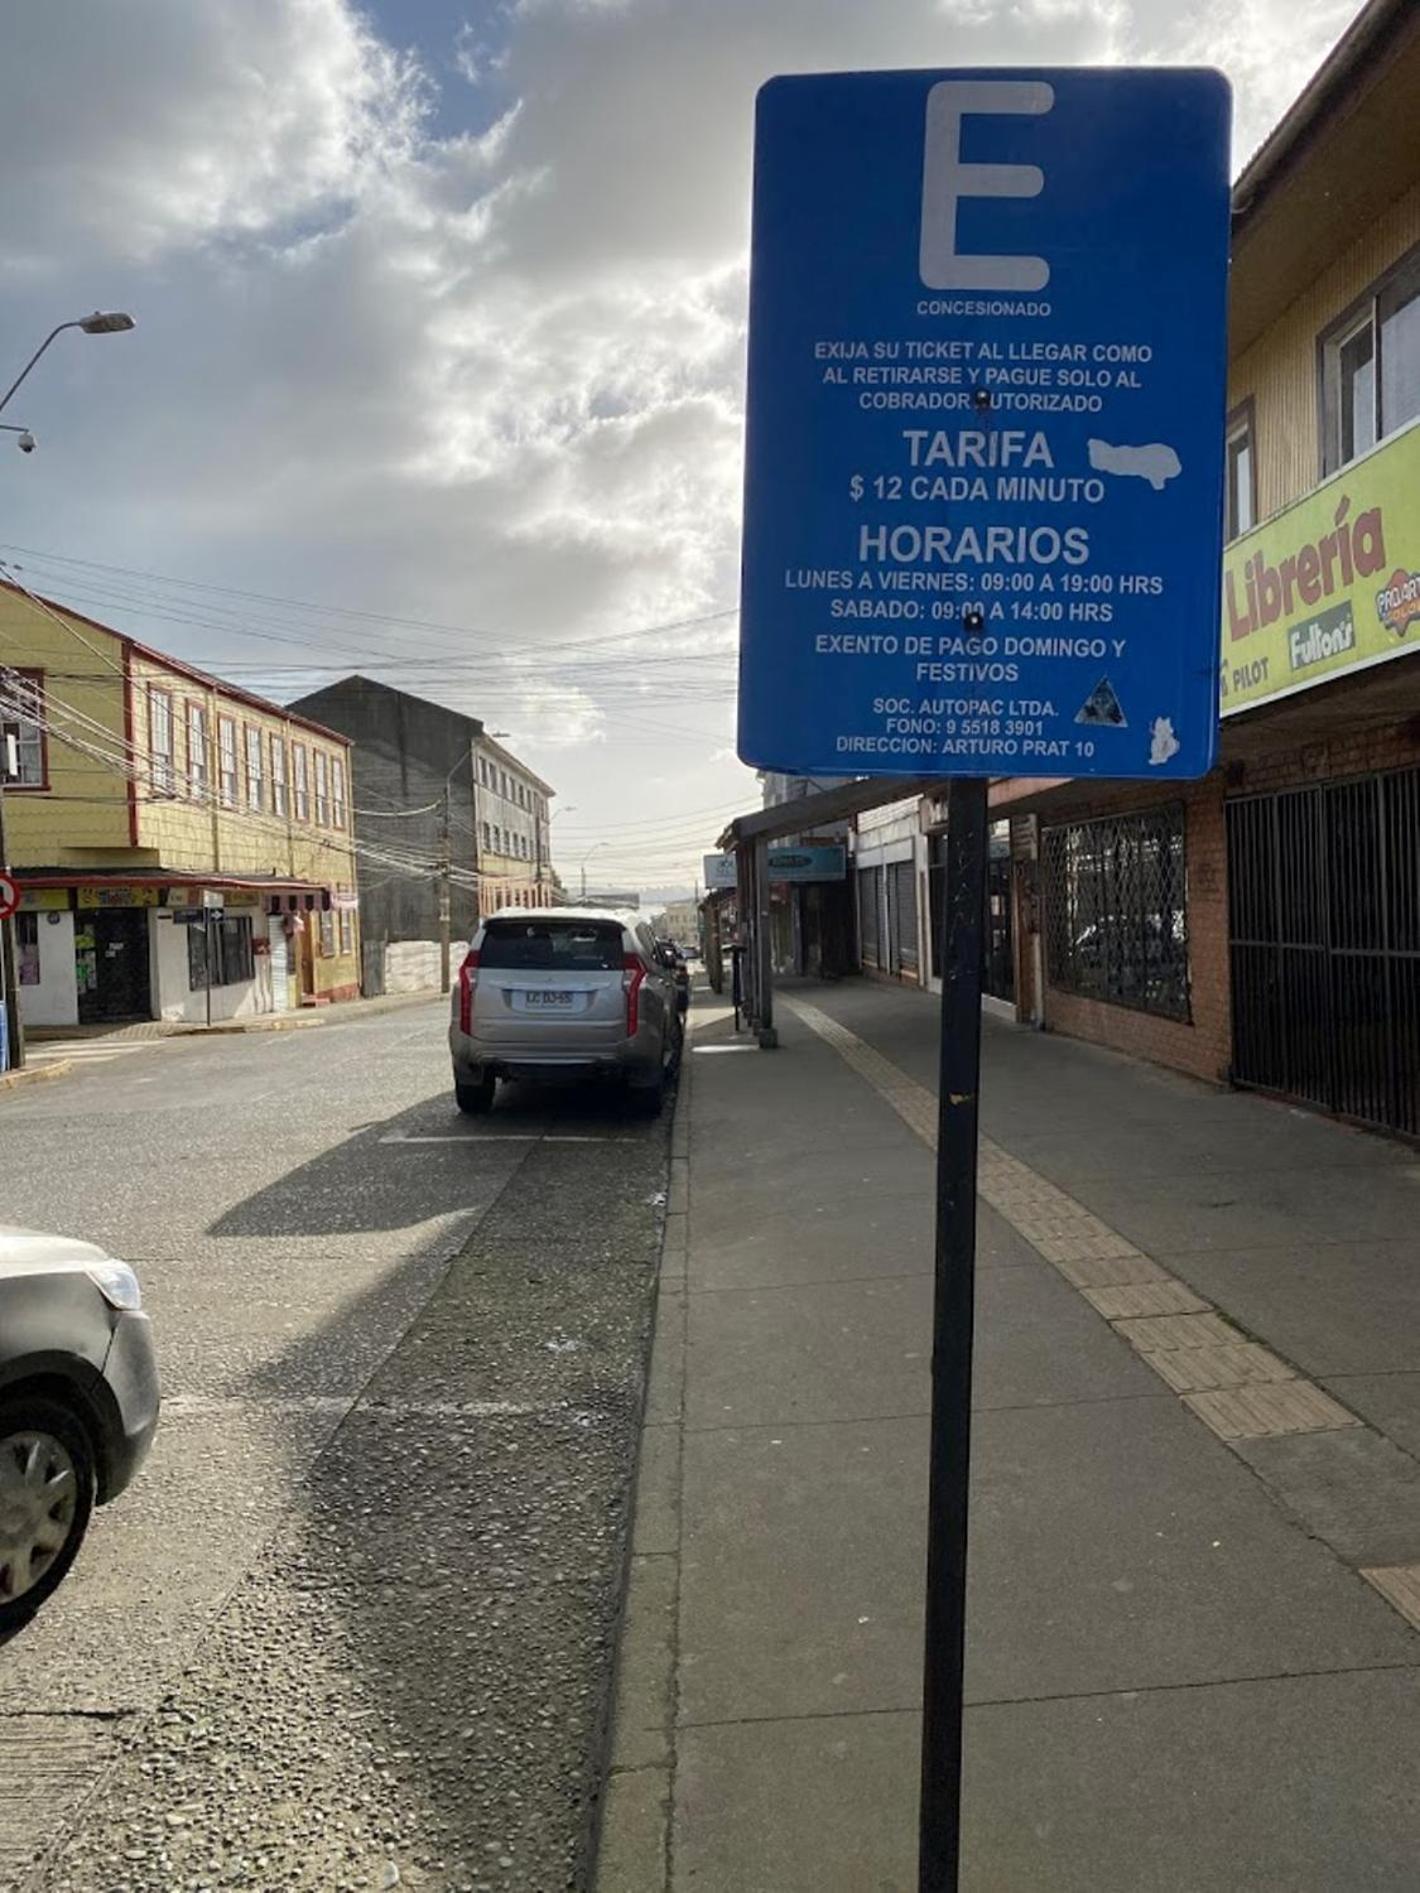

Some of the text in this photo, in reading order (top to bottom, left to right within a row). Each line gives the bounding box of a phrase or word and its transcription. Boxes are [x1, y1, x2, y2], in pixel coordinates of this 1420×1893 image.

[918, 81, 1056, 292] E
[916, 300, 1052, 318] CONCESIONADO
[814, 341, 1153, 364] EXIJA SU TICKET AL LLEGAR COMO
[822, 367, 1142, 389] AL RETIRARSE Y PAGUE SOLO AL
[859, 391, 1103, 413] COBRADOR UTORIZADO
[903, 430, 1055, 469] TARIFA
[849, 475, 1105, 504] $ 12 CADA MINUTO
[859, 524, 1090, 566] HORARIOS
[1226, 495, 1386, 642] Librería
[785, 569, 1164, 595] LUNES A VIERNES: 09:00 A 19:00 HRS
[830, 599, 925, 620] SABADO:
[989, 601, 1005, 620] A
[1010, 601, 1064, 621] 14:00
[1068, 603, 1113, 622] HRS
[815, 635, 1127, 658] EXENTO DE PAGO DOMINGO Y
[916, 663, 1019, 683] FESTIVOS
[1232, 656, 1270, 692] PILOT
[872, 697, 1059, 718] SOC. AUTOPAC LTDA.
[886, 719, 1043, 737] FONO: 9 5518 3901
[836, 736, 1095, 758] DIRECCION: ARTURO PRAT 10
